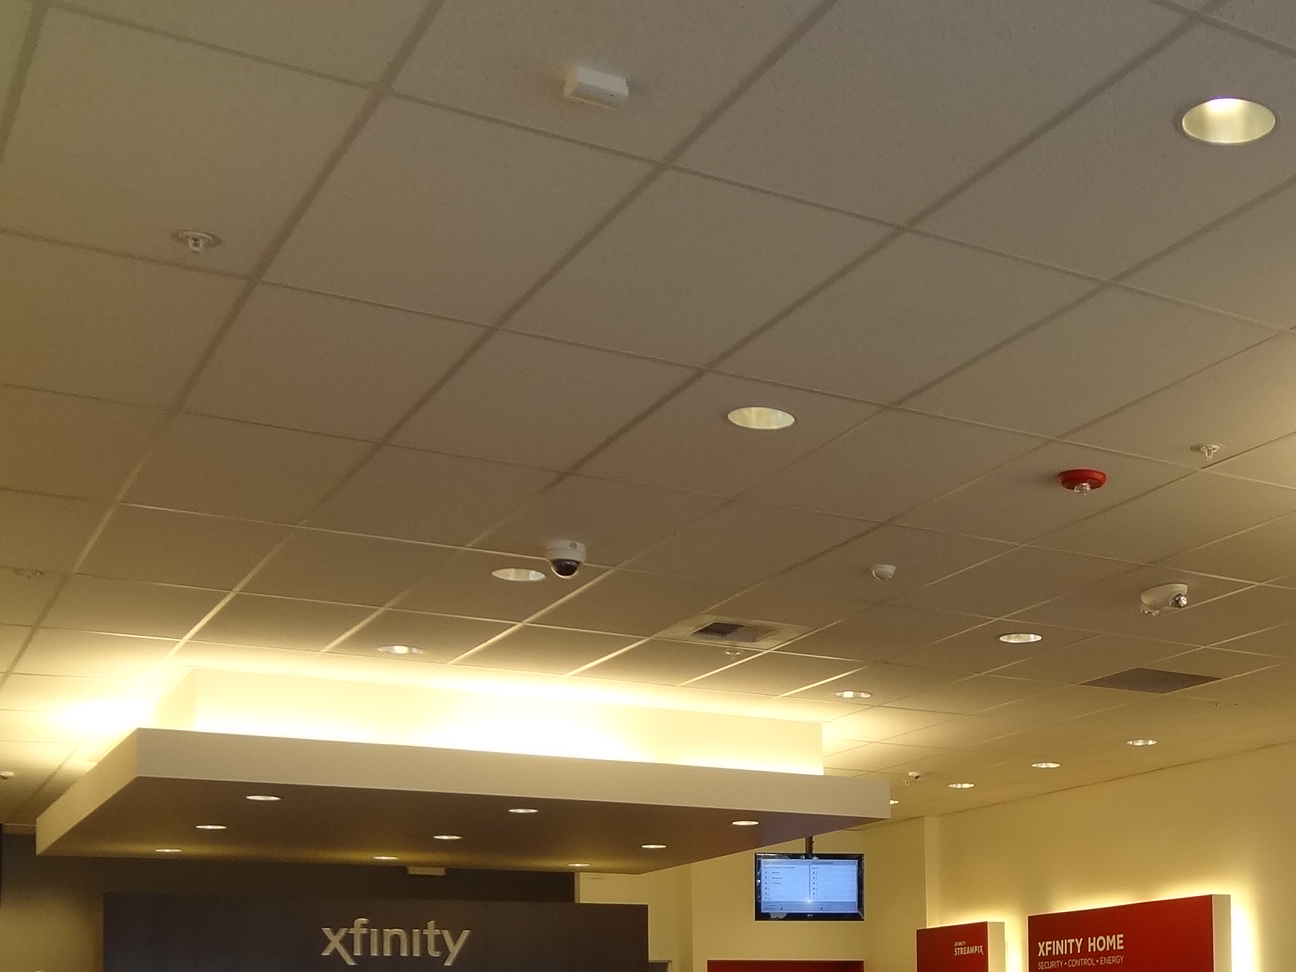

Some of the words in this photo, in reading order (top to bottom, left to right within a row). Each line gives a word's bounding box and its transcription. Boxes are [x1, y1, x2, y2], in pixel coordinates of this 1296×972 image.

[320, 917, 472, 966] xfinity
[1037, 938, 1083, 957] XFINITY
[1088, 933, 1124, 953] HOME
[1038, 960, 1064, 970] SECURITY
[1067, 957, 1095, 967] CONTROL
[1099, 955, 1124, 965] ENERGY
